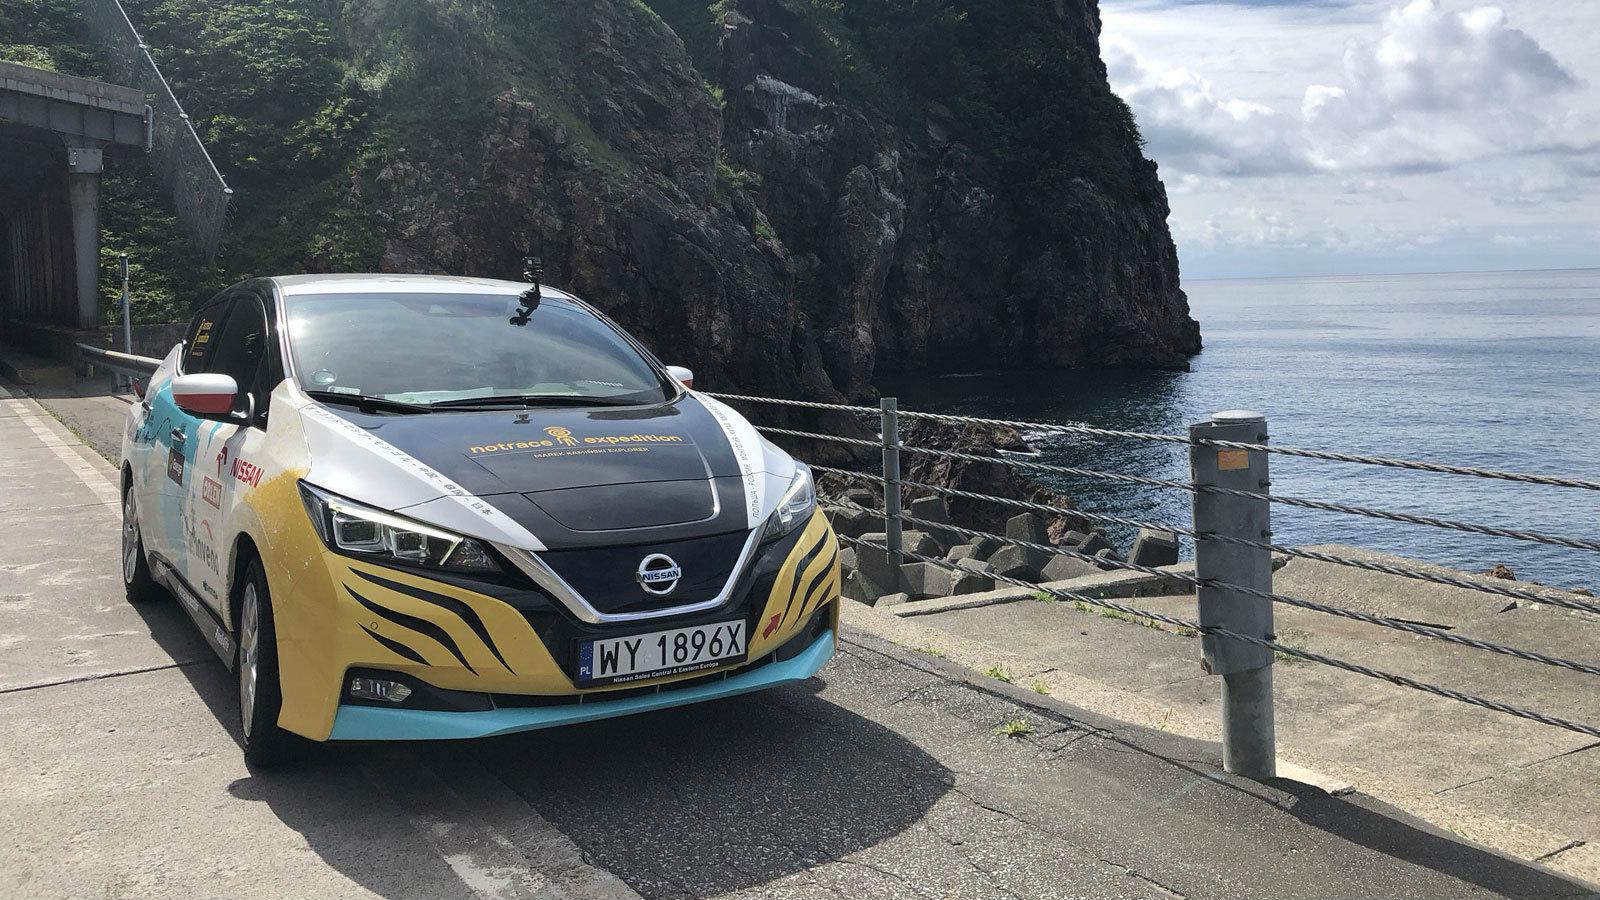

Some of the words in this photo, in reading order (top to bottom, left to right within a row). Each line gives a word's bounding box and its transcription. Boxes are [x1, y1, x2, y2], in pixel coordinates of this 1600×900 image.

[469, 438, 553, 454] notrace
[584, 434, 683, 445] expedition
[533, 451, 564, 459] MAREK
[607, 447, 649, 455] EXPLORER
[229, 457, 265, 489] NISSAN
[470, 501, 494, 516] 日本
[642, 570, 680, 581] NISSAN
[600, 638, 642, 675] WY
[657, 623, 742, 666] 1896X
[580, 666, 591, 676] PL
[613, 675, 634, 683] Nissan
[634, 673, 650, 681] Sales
[651, 670, 672, 678] Central
[679, 665, 699, 673] Eastern
[700, 662, 719, 671] Europe
